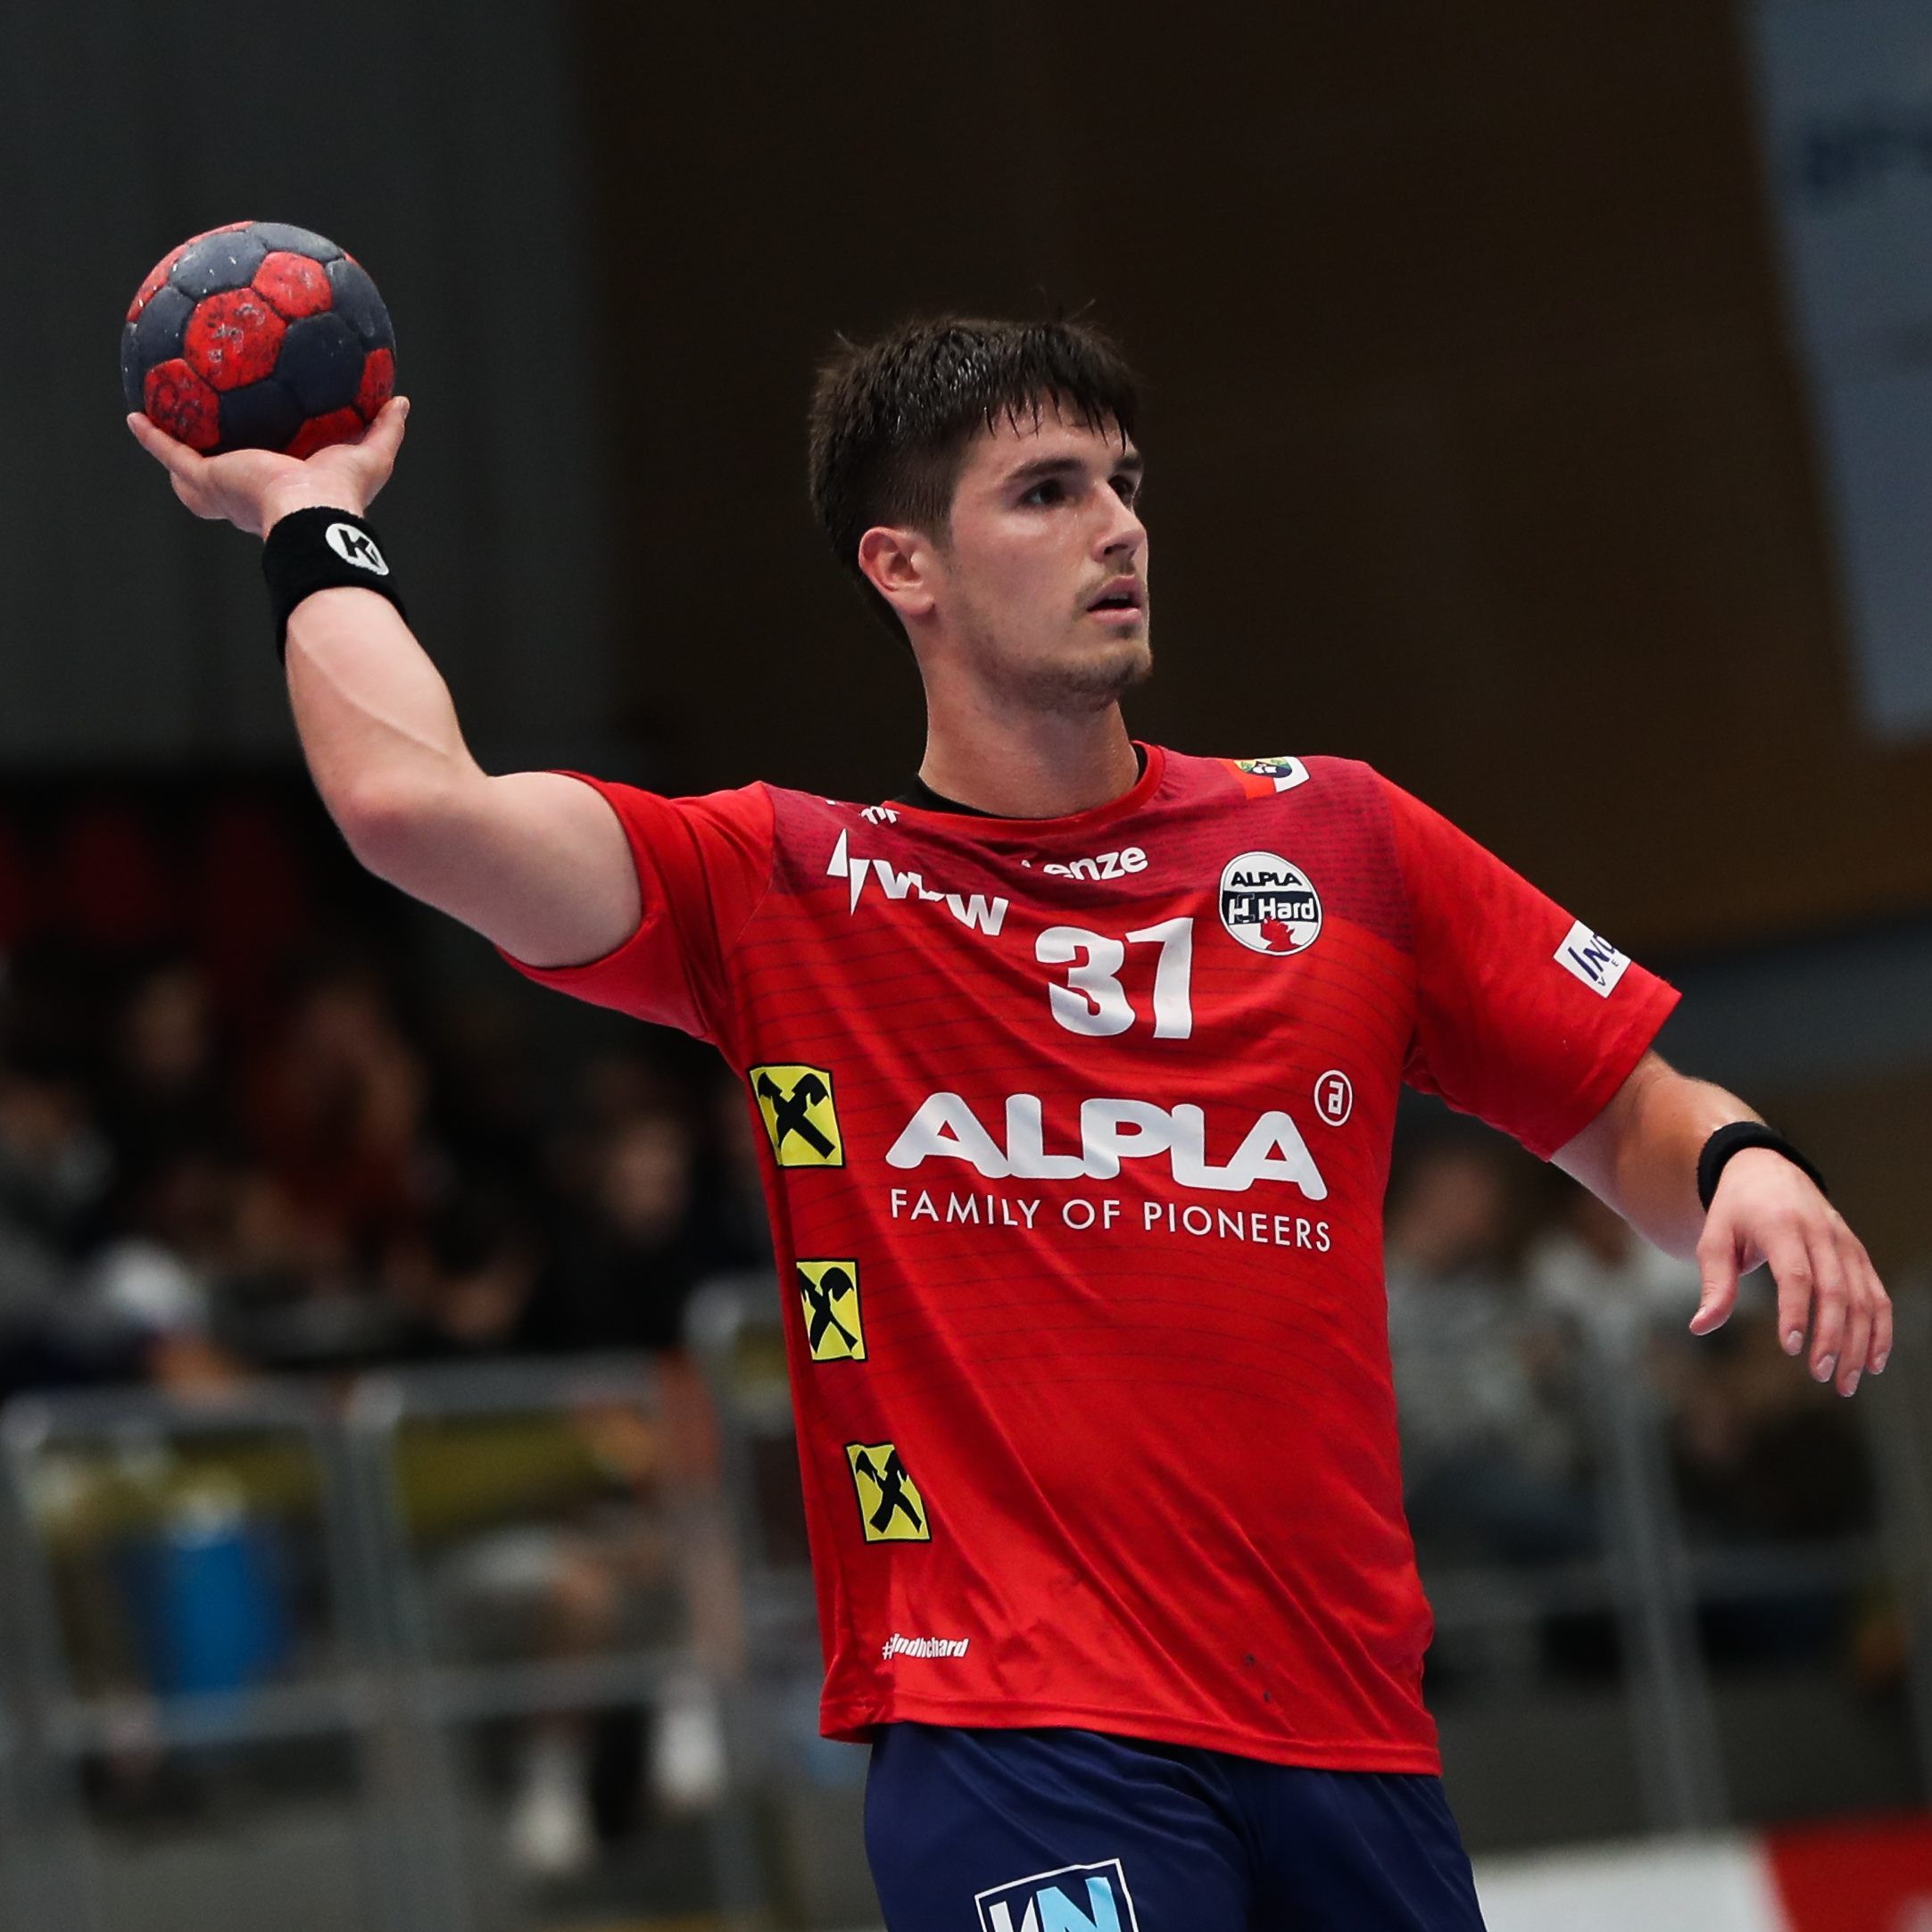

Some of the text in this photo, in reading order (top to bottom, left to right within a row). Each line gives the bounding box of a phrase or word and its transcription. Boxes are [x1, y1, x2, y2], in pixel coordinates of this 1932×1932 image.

[1022, 847, 1148, 881] enze
[1231, 871, 1303, 888] ALPLA
[1257, 897, 1315, 921] Hard
[1034, 916, 1194, 1040] 37
[885, 1091, 1328, 1201] ALPLA
[891, 1188, 1331, 1252] FAMILY OF PIONEERS
